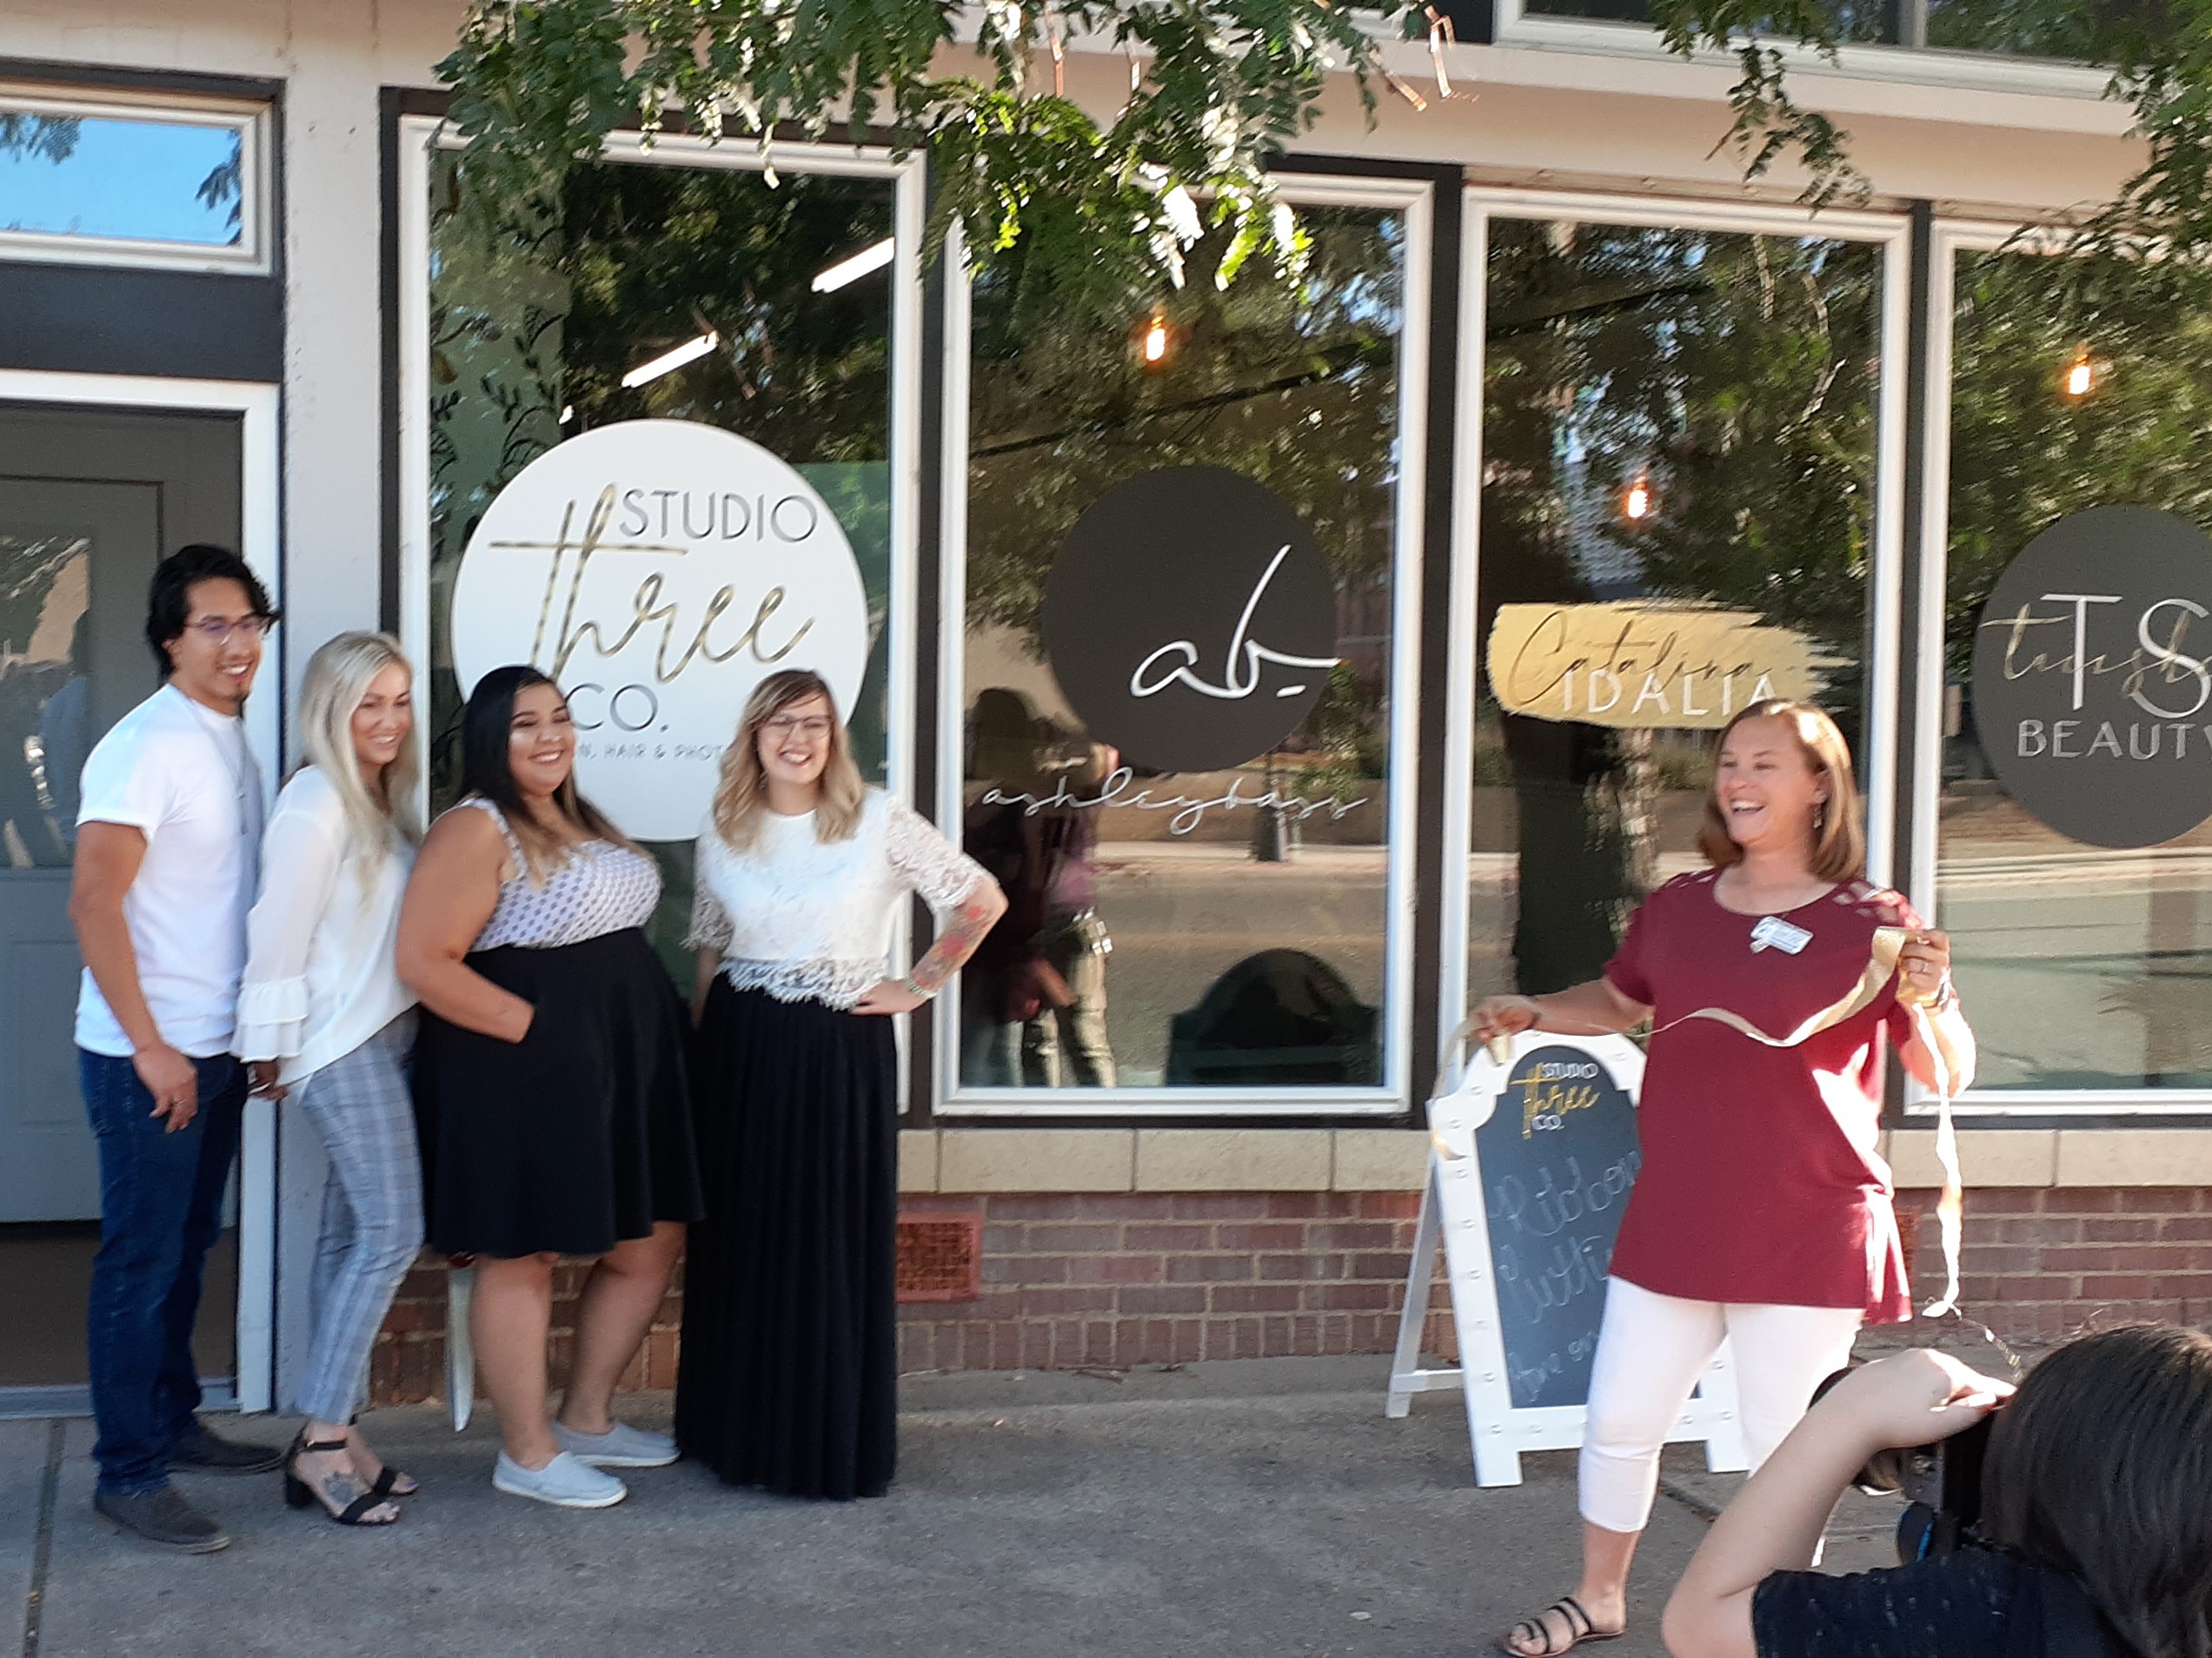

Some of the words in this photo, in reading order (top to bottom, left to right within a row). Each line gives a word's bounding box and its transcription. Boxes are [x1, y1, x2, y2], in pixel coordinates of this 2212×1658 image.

[618, 488, 819, 543] STUDIO
[488, 482, 815, 684] three
[565, 682, 669, 731] CO.
[1563, 669, 1777, 718] IDALIA
[673, 744, 724, 760] PHOT
[2016, 719, 2212, 760] BEAUT
[1542, 1062, 1599, 1079] STUDIO
